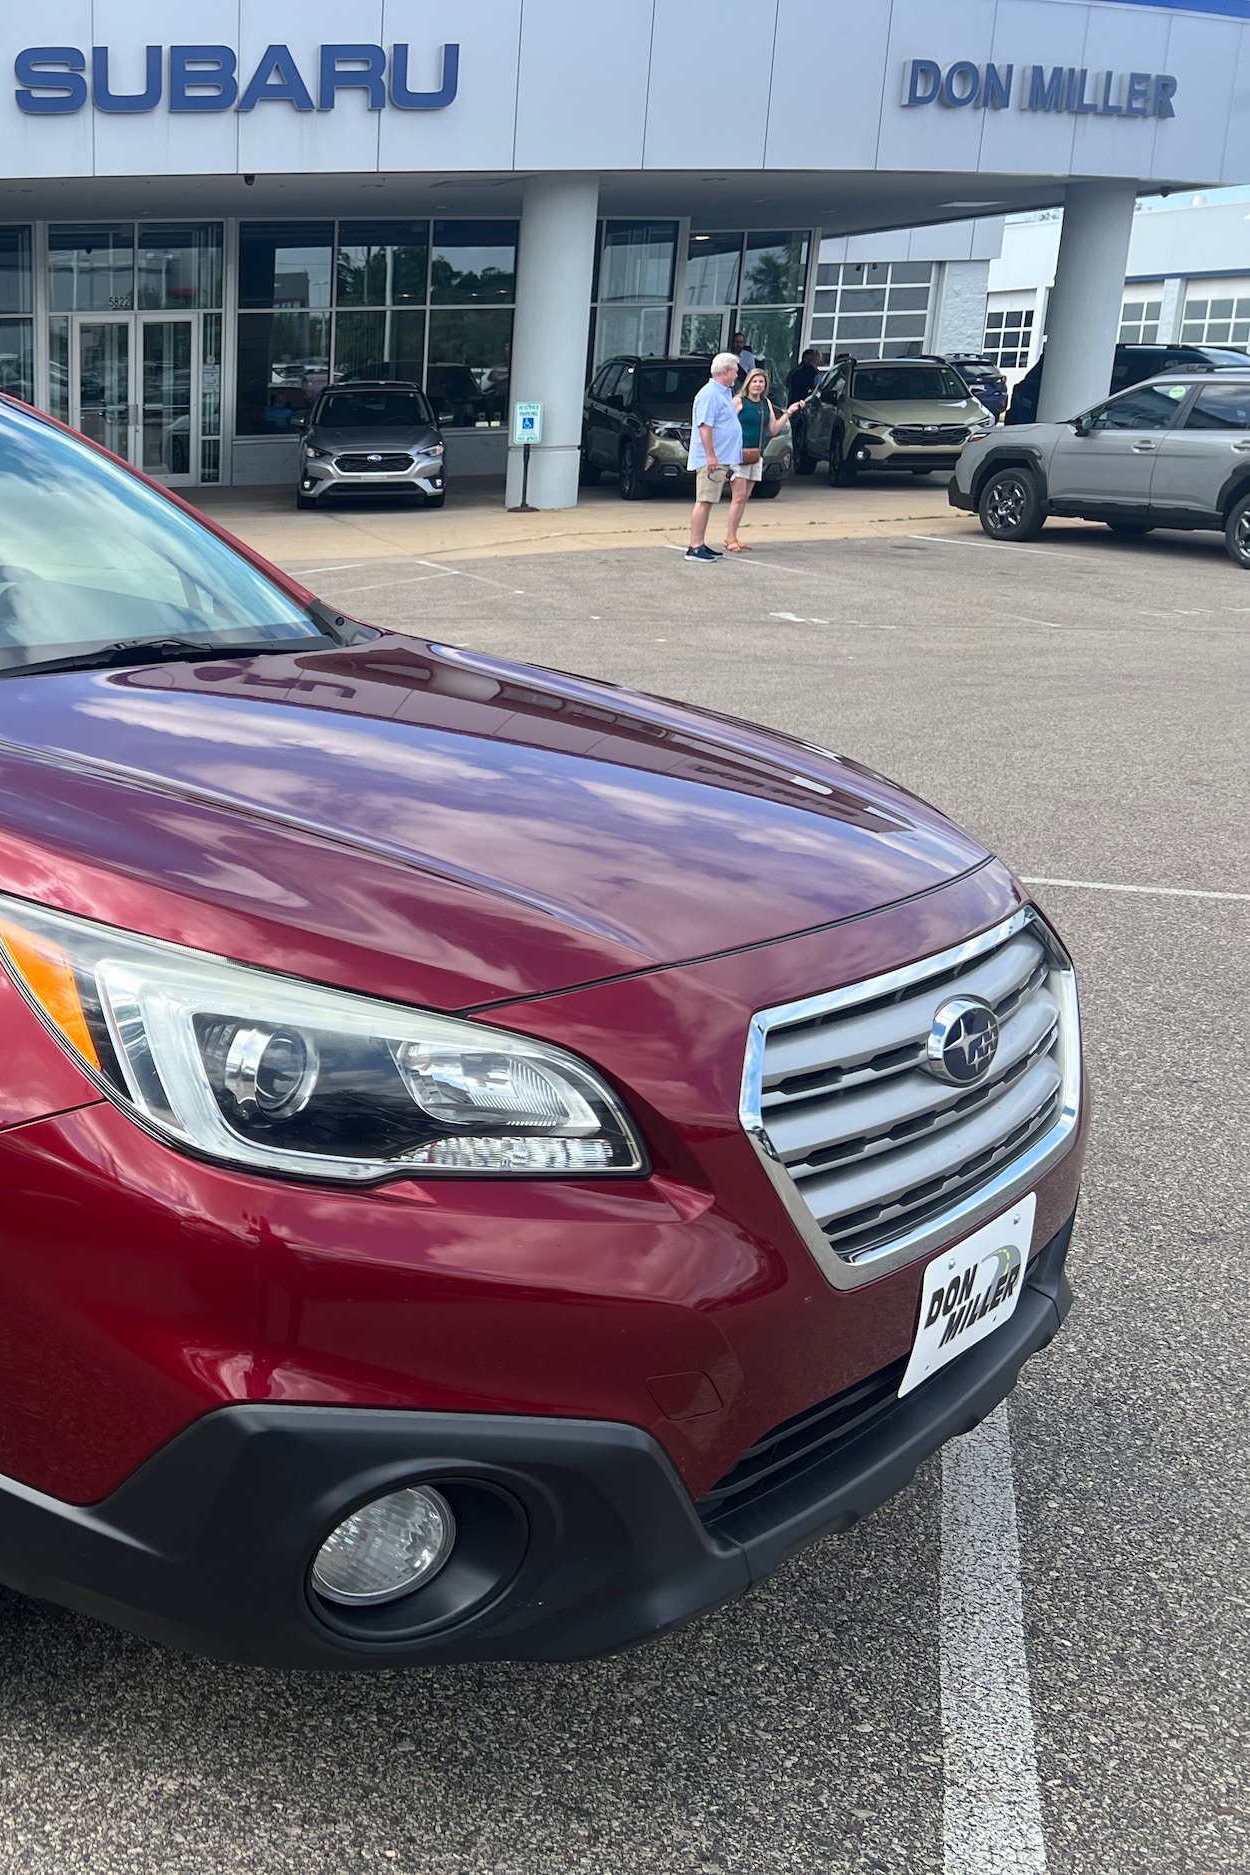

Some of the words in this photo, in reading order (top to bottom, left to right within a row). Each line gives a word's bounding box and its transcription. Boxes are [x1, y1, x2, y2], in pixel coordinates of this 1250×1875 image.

[14, 43, 461, 115] SUBARU
[901, 58, 1014, 109] DON
[1020, 64, 1178, 119] MILLER
[923, 1262, 979, 1331] DON
[937, 1263, 1021, 1350] MILLER
